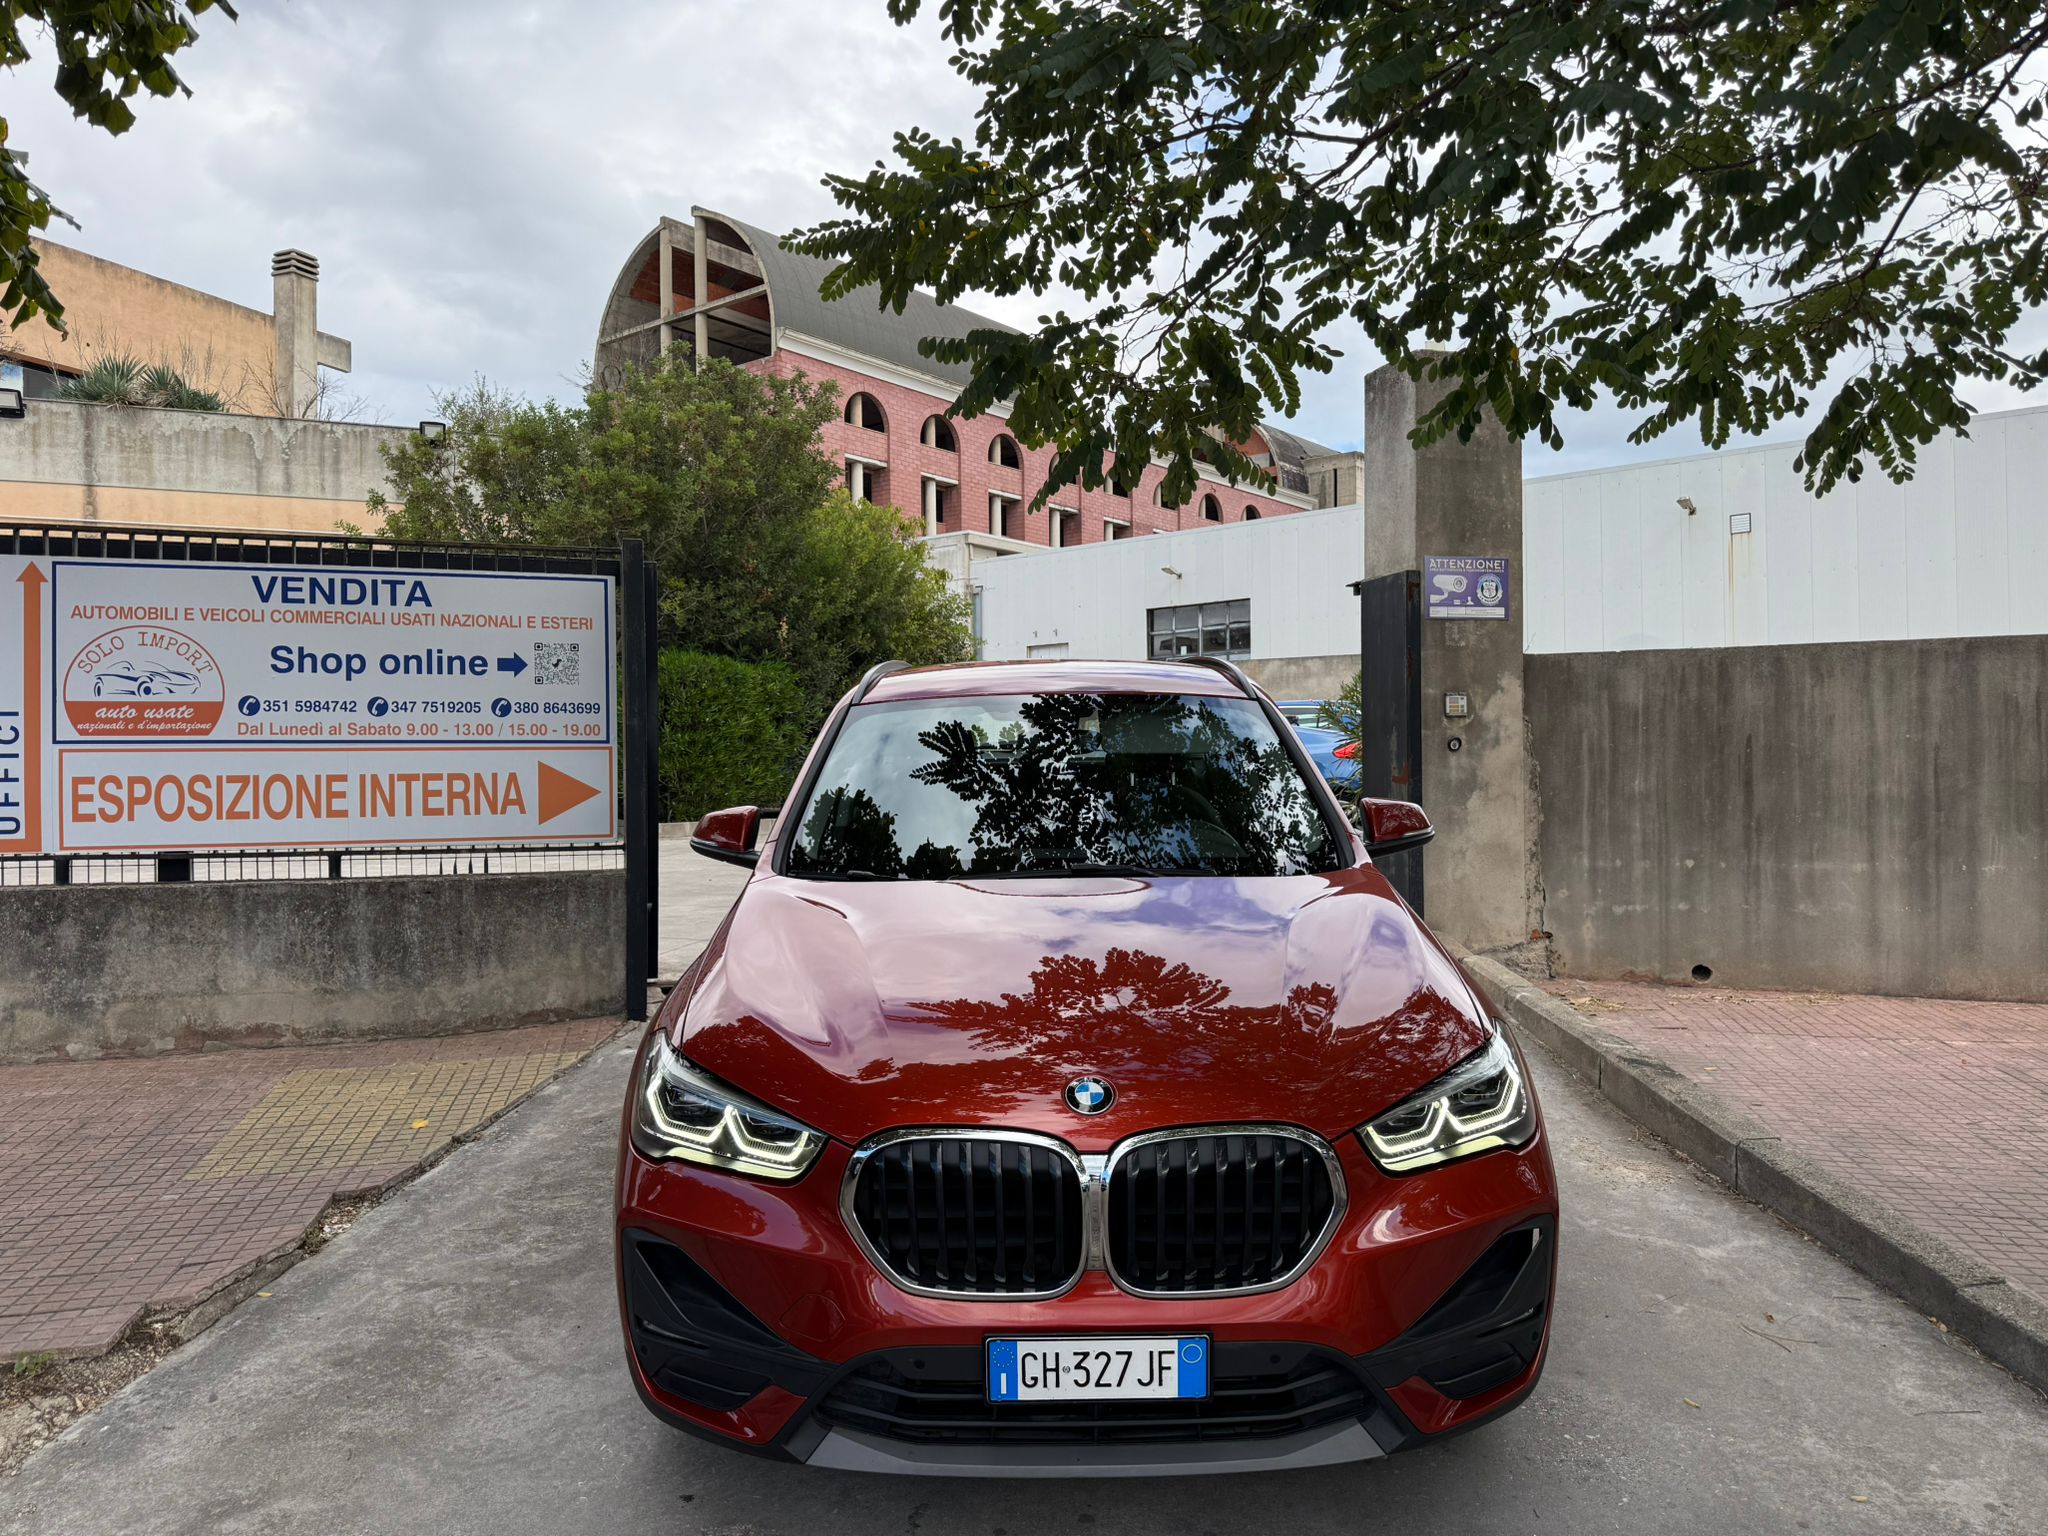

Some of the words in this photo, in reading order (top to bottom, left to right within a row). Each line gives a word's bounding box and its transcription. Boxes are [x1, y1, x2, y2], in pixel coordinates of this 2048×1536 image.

[1429, 559, 1505, 570] ATTENZIONE!
[251, 575, 432, 607] VENDITA
[71, 605, 178, 621] AUTOMOBILI
[184, 607, 195, 621] E
[199, 608, 265, 623] VEICOLI
[270, 609, 386, 625] COMMERCIALI
[391, 612, 435, 627] USATI
[440, 613, 522, 629] NAZIONALI
[526, 616, 537, 629] E
[541, 616, 593, 630] ESTERI
[77, 635, 125, 674] SOLO
[137, 631, 214, 674] IMPORT
[270, 645, 367, 681] Shop
[379, 649, 488, 676] online
[95, 706, 138, 719] auto
[143, 706, 194, 719] usate
[263, 700, 288, 713] 351
[294, 700, 357, 713] 5984742
[391, 701, 417, 713] 347
[422, 701, 481, 714] 7519205
[514, 702, 539, 714] 380
[543, 702, 601, 715] 8643699
[77, 720, 126, 733] nazionali
[137, 720, 212, 733] d'importazione
[237, 722, 263, 736] Dal
[269, 721, 323, 736] Lunedì
[328, 722, 342, 736] al
[347, 722, 402, 737] Sabato
[406, 723, 438, 736] 9.00
[454, 723, 494, 736] 13.00
[508, 723, 547, 736] 15.00
[562, 724, 601, 737] 19.00
[71, 774, 348, 823] ESPOSIZIONE
[358, 772, 527, 818] INTERNA
